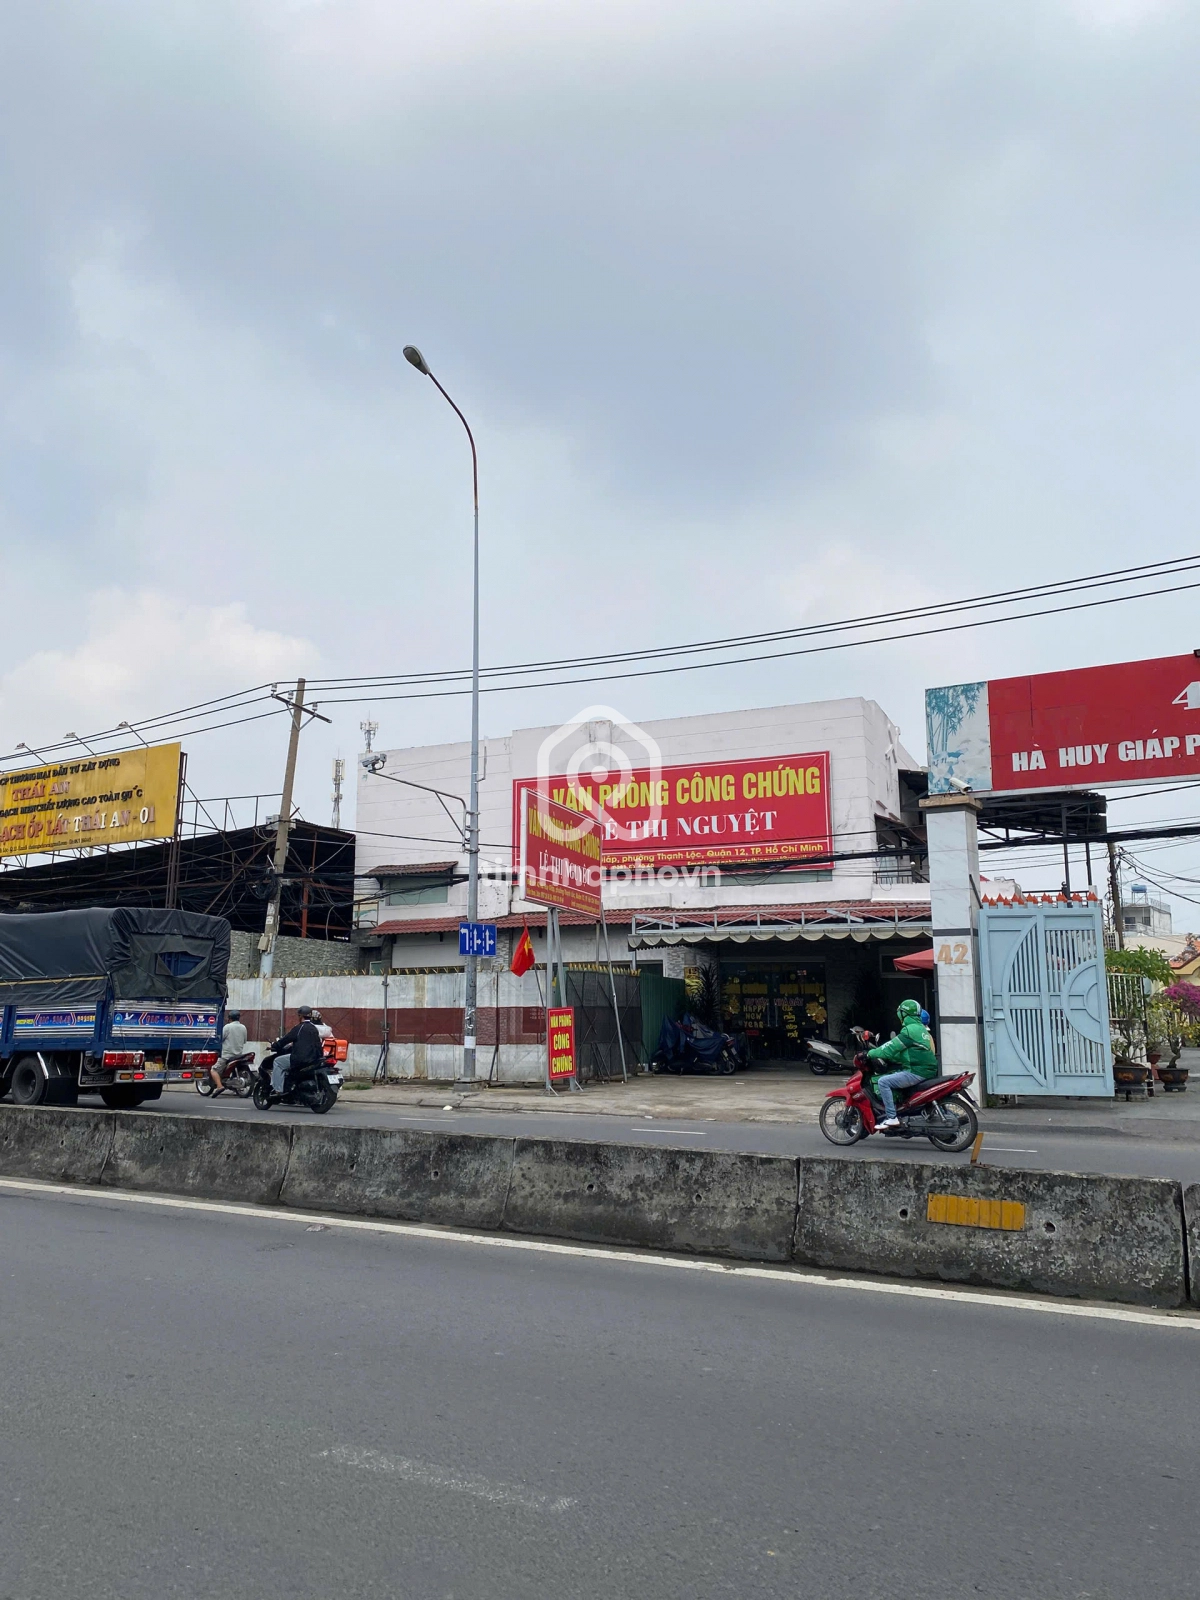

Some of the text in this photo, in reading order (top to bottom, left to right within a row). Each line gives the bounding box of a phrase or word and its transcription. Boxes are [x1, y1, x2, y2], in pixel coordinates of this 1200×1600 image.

[70, 763, 80, 775] TƯ
[98, 757, 120, 771] DỰNG
[1012, 743, 1046, 772] HÀ
[1058, 743, 1109, 768] HUY
[12, 781, 70, 802] THÁI AN
[81, 795, 97, 806] CAO
[98, 790, 120, 803] TOÀN
[553, 764, 821, 811] VĂN PHÒNG CÔNG CHỨNG
[0, 823, 26, 845] ẠCH
[27, 814, 43, 839] ỐP
[46, 813, 70, 837] LÁT
[74, 807, 107, 832] THÁI
[109, 810, 131, 828] AN
[543, 810, 565, 846] PHÒNG
[566, 820, 581, 854] CÔNG
[601, 808, 777, 841] Ê THỊ NGUYỆT
[601, 854, 620, 865] iáp,
[621, 852, 655, 866] phường
[657, 850, 684, 862] Thạnh
[707, 848, 732, 860] Quận
[765, 844, 779, 854] Hồ
[781, 843, 798, 853] Chí
[800, 843, 824, 853] Minh
[539, 849, 548, 871] LÊ
[550, 855, 563, 879] THỊ
[565, 858, 591, 887] NGUYỆT
[937, 943, 969, 965] 42
[553, 1032, 570, 1050] CÔNG
[552, 1054, 572, 1074] CHỨNG
